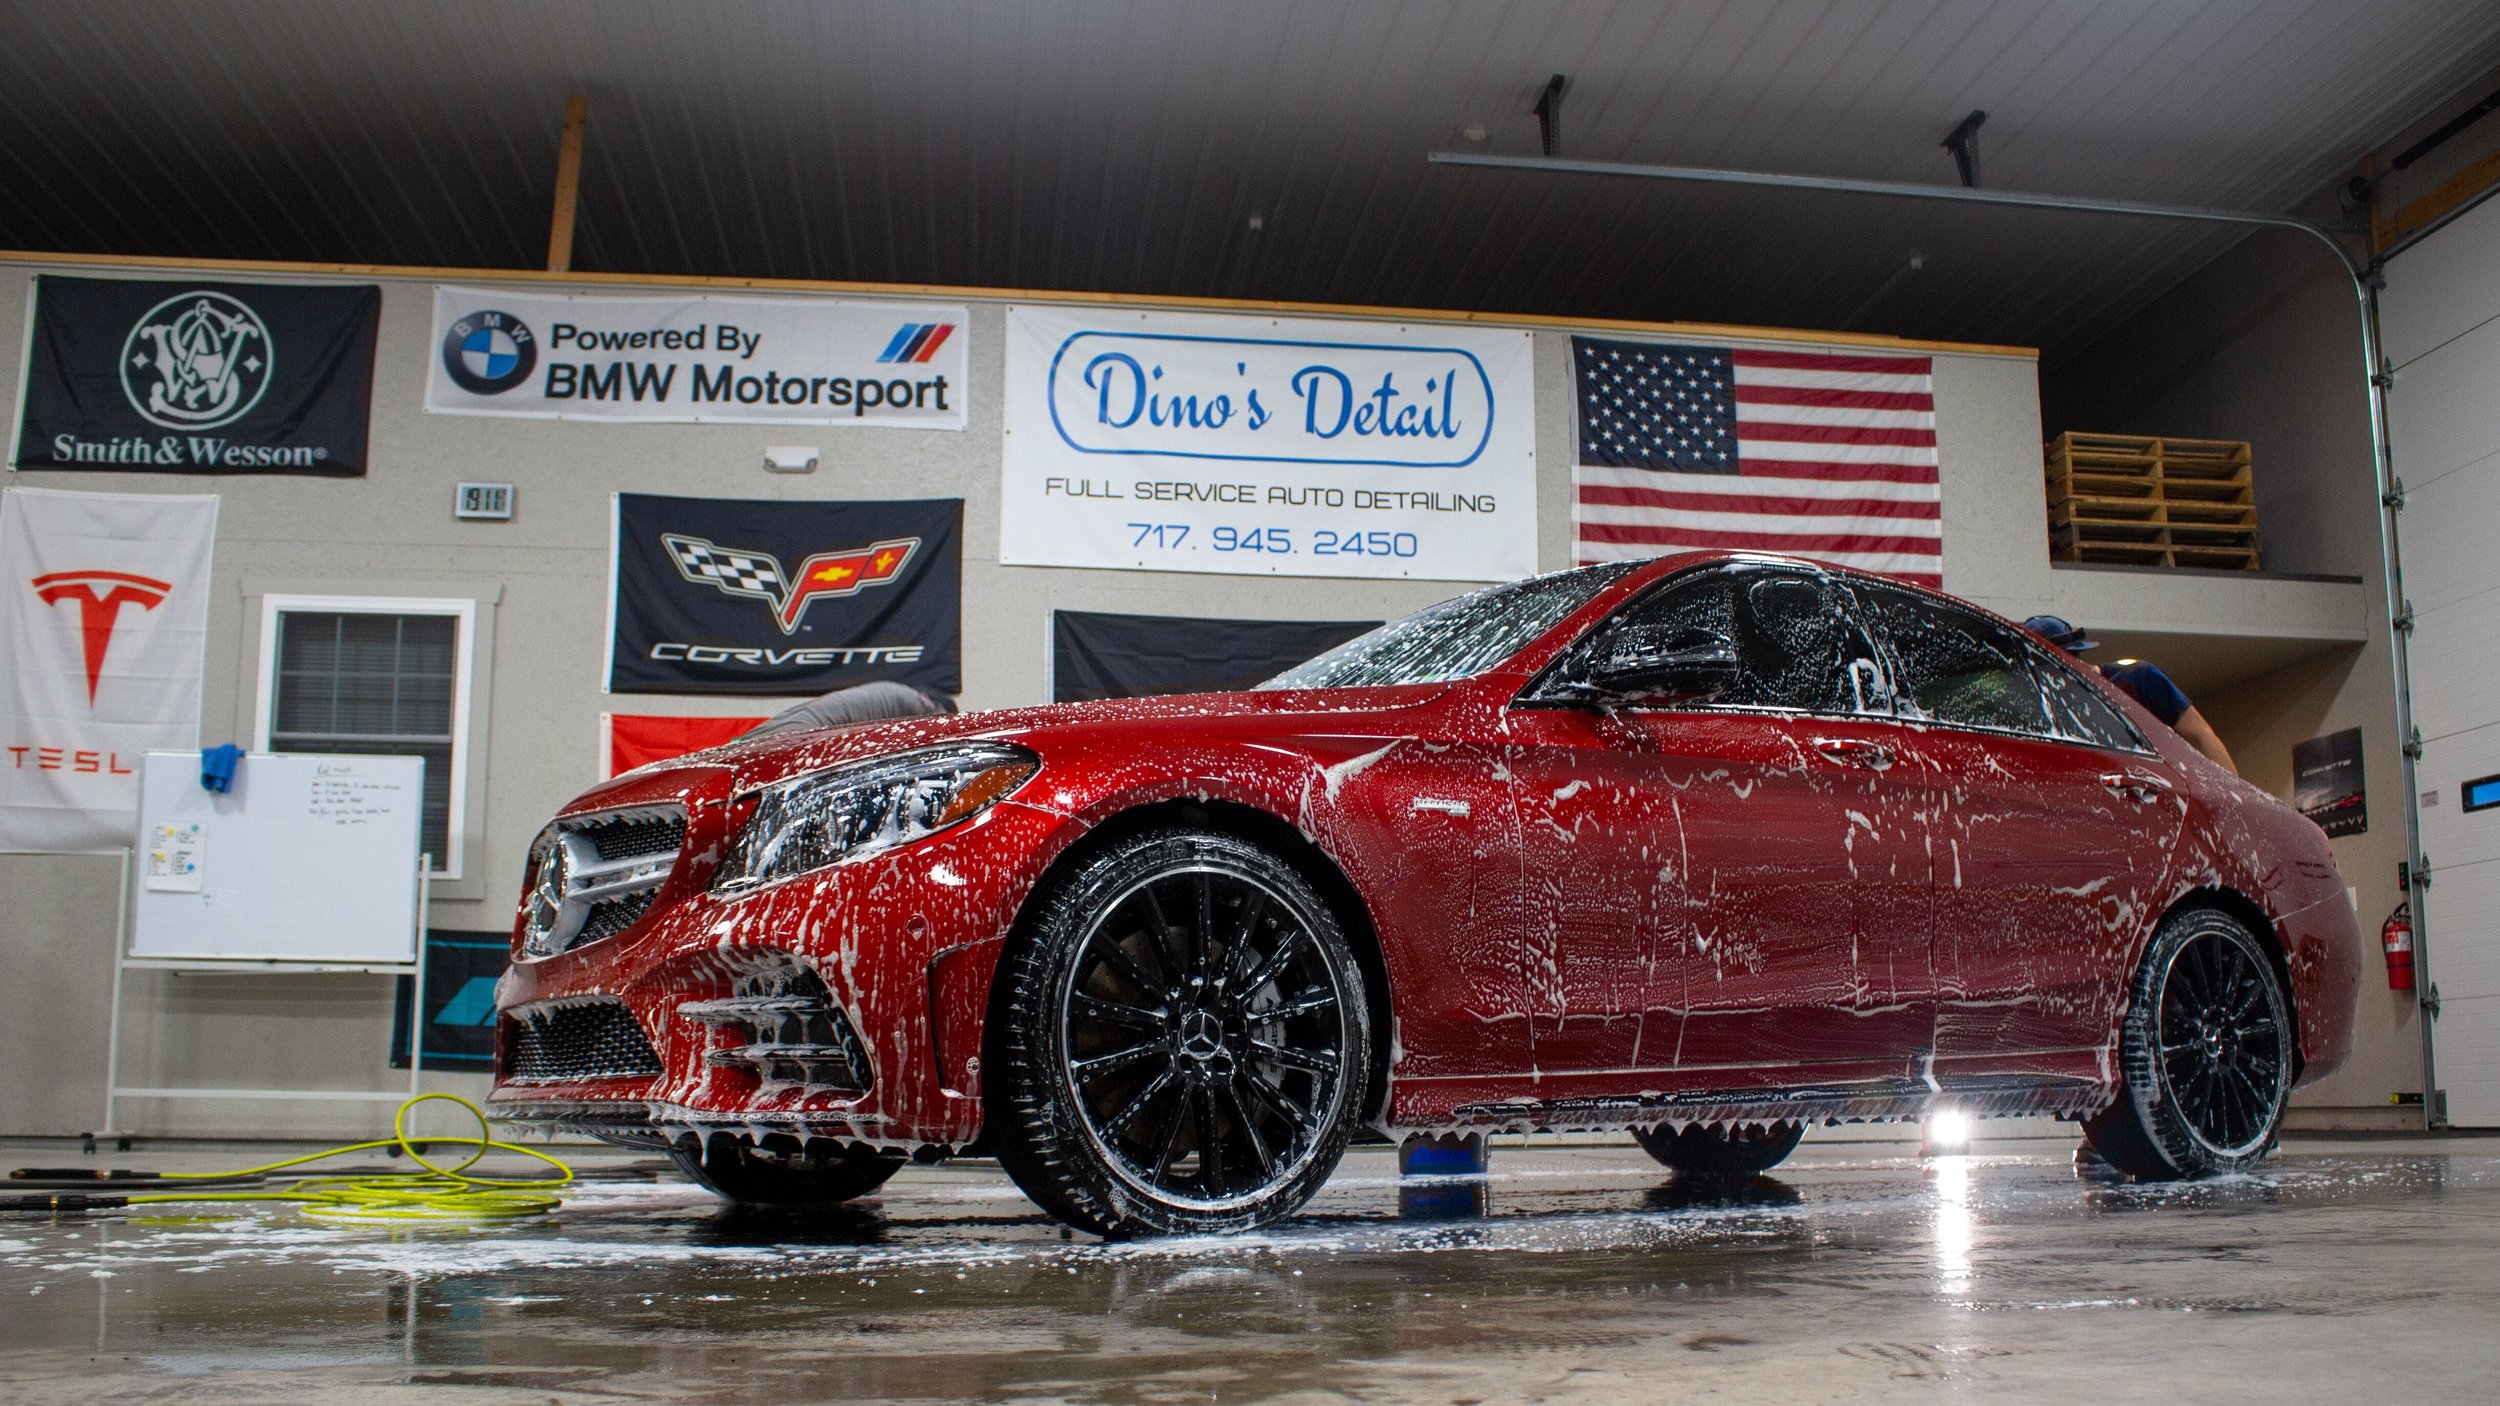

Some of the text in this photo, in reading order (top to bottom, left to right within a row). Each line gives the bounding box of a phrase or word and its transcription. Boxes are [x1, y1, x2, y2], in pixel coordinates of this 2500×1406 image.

[454, 313, 531, 343] BMW
[551, 324, 762, 359] Powered By
[544, 362, 949, 416] BMW Motorsport
[1084, 352, 1461, 439] Dino's Detail
[1045, 477, 1497, 513] FULL SERVICE AUTO DETAILING
[1127, 523, 1418, 557] 717. 945. 2450
[650, 642, 925, 665] CORVETTE
[7, 746, 133, 774] TESL
